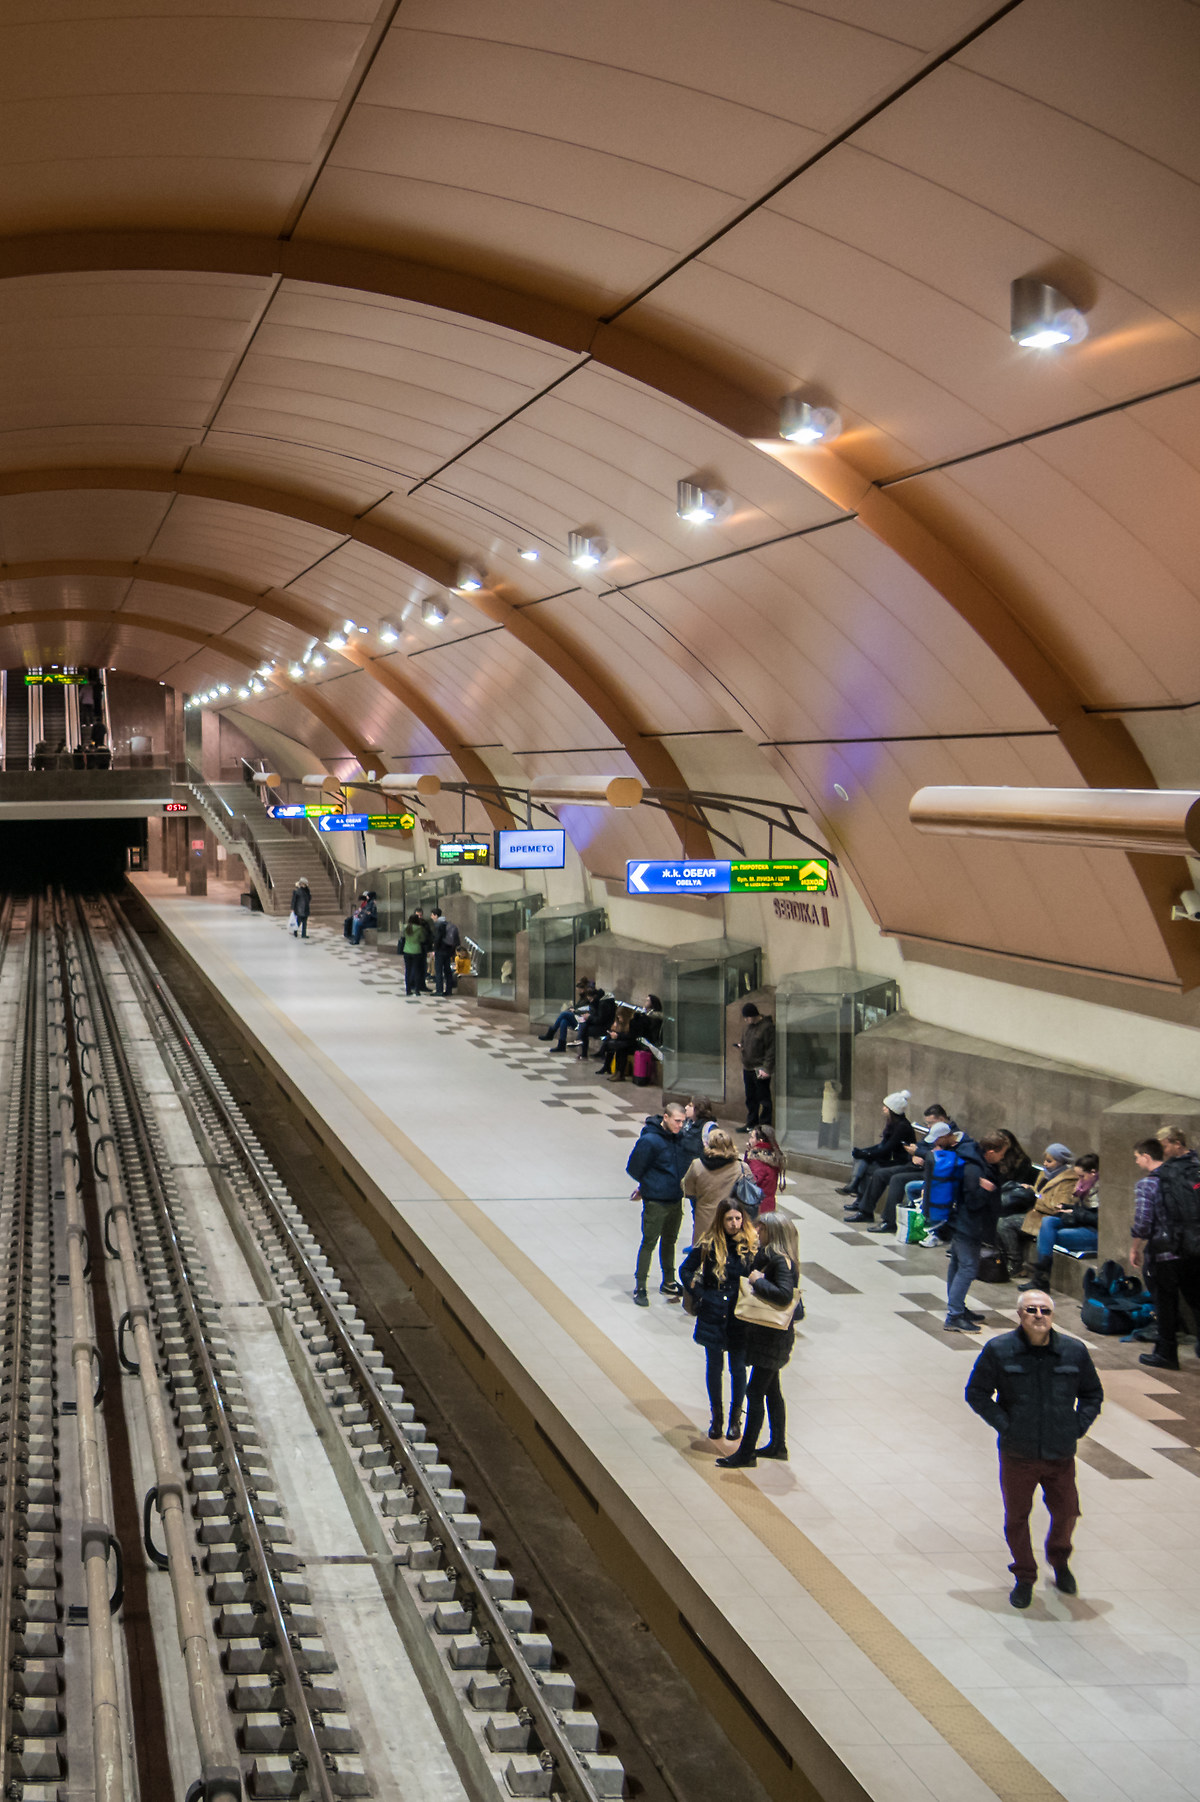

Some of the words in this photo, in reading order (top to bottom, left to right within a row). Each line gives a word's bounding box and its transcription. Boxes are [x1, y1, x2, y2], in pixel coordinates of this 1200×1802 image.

[509, 845, 554, 853] ВРЕМЕТО
[683, 868, 716, 878] ОБЕЛЯ
[773, 898, 820, 926] SERDIKA
